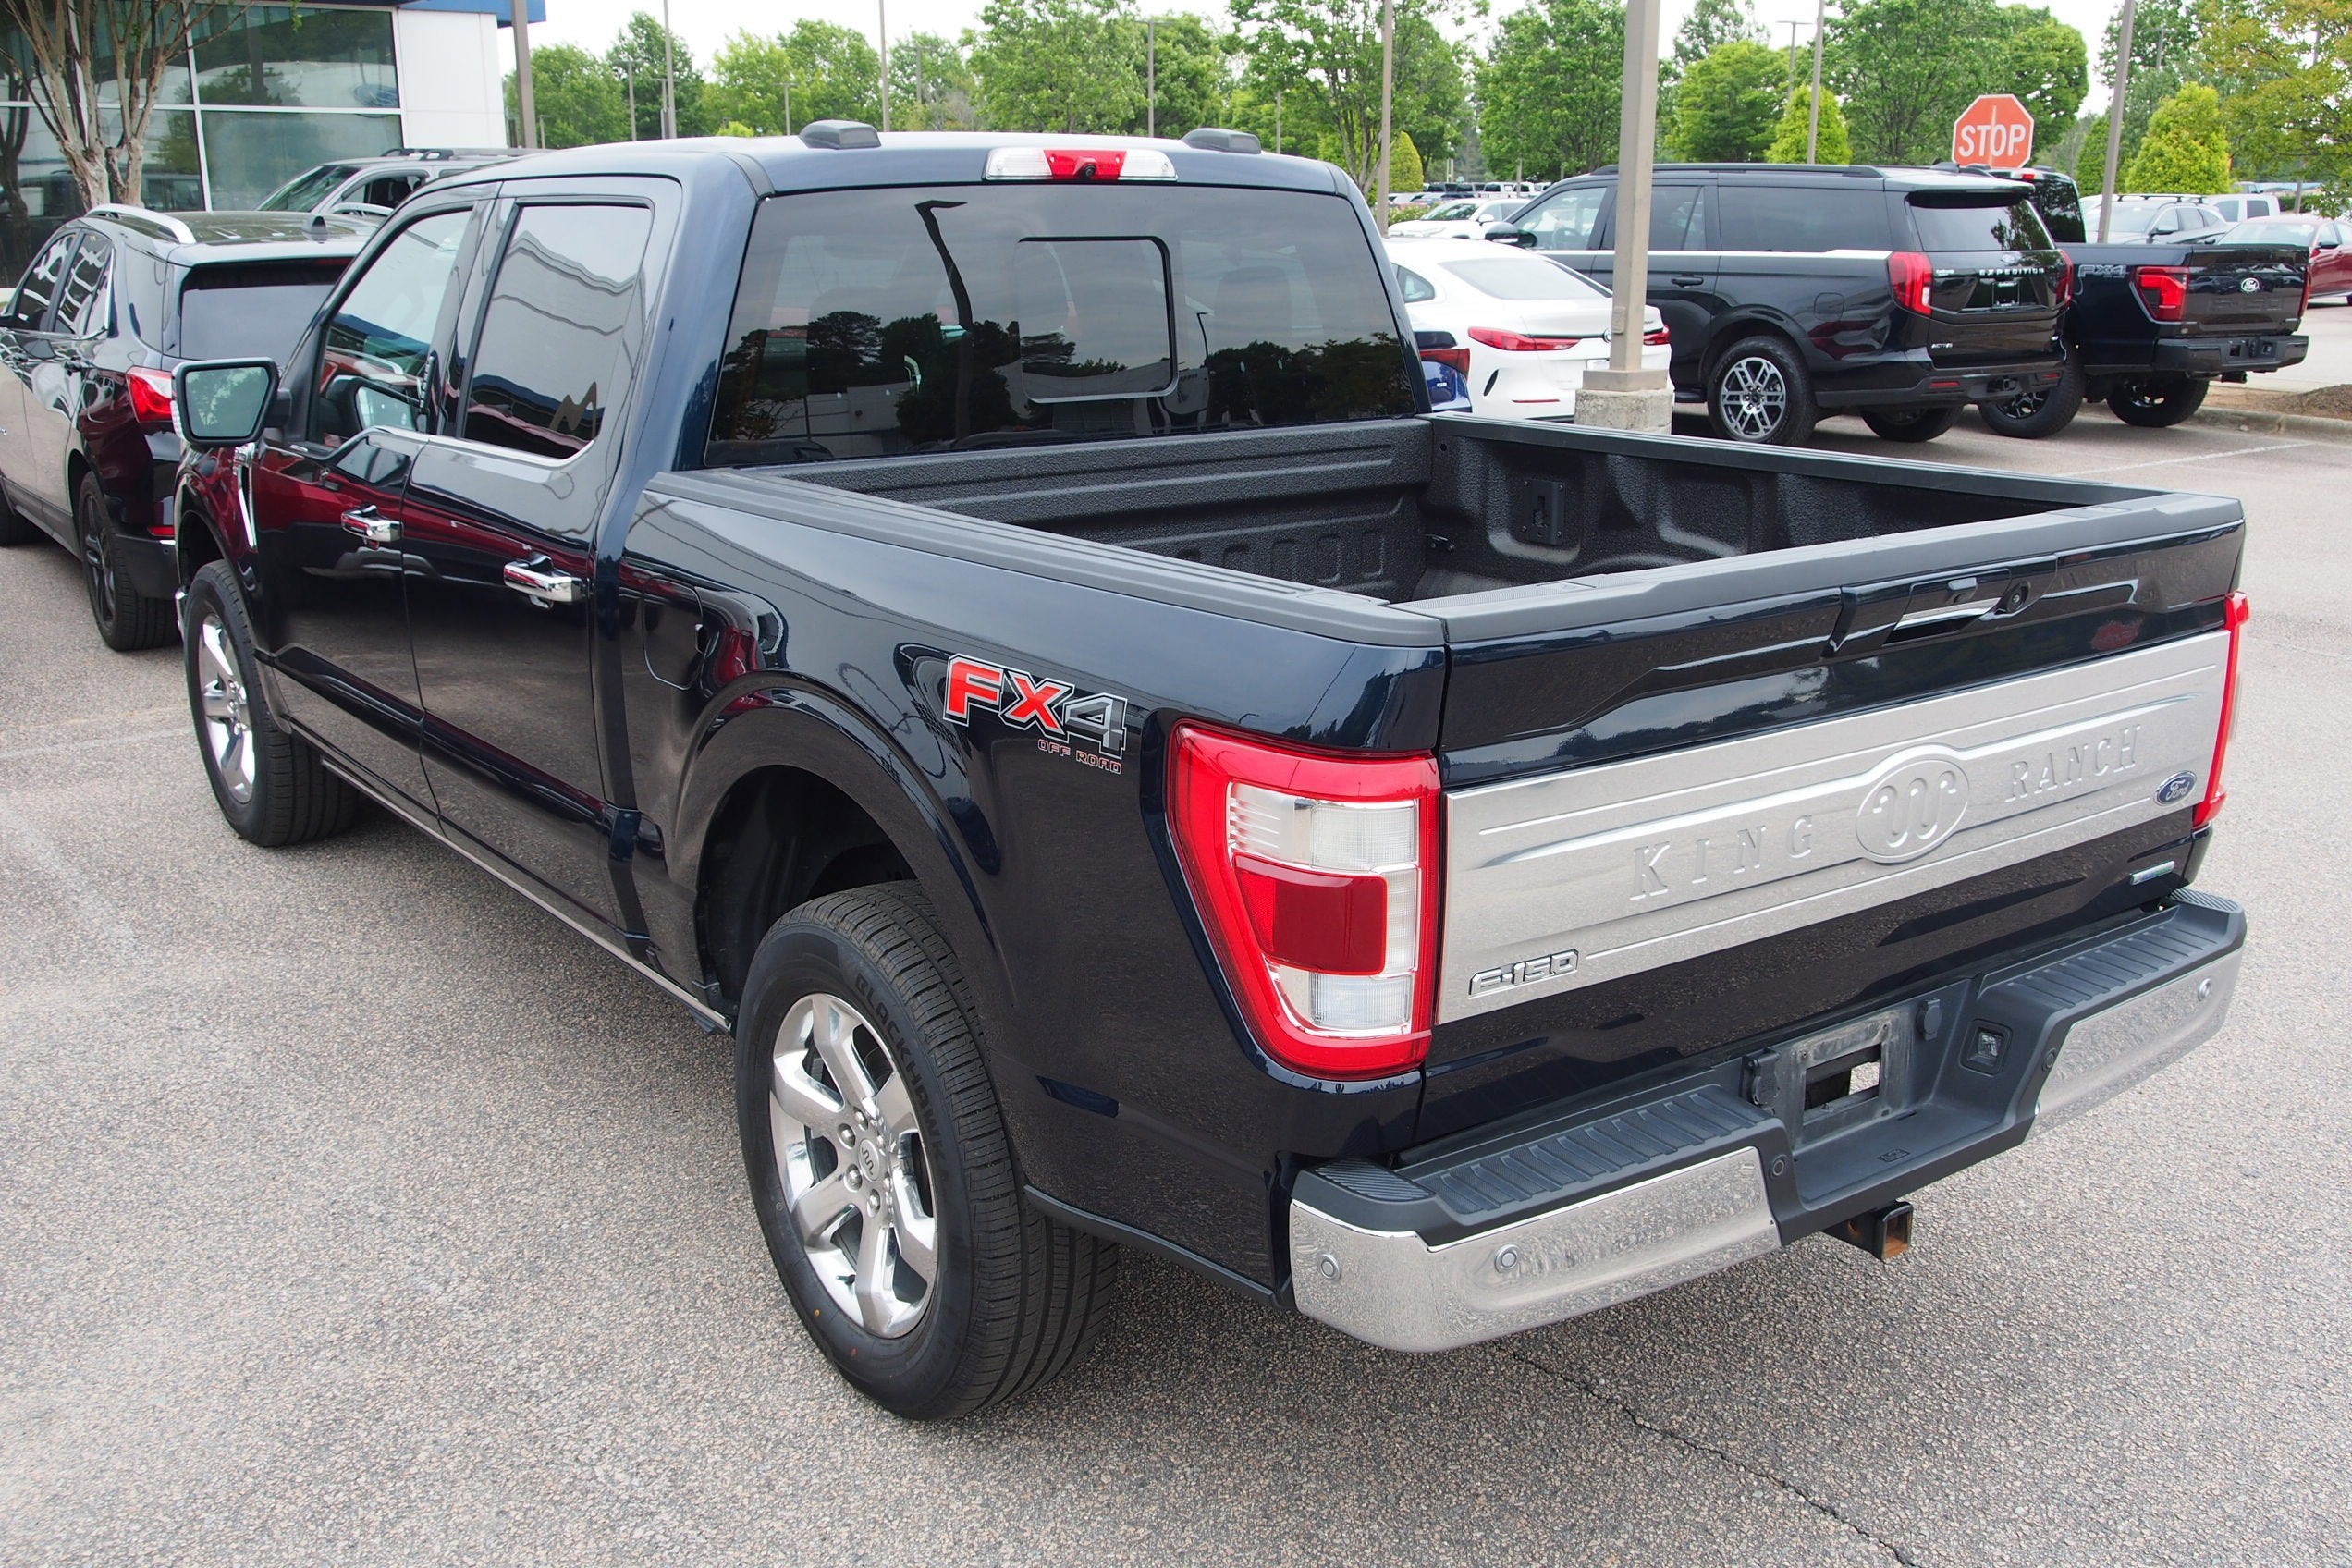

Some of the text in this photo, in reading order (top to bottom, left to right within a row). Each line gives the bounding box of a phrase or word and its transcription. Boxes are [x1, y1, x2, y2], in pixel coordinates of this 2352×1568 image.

[1959, 123, 2027, 157] STOP
[1978, 267, 2045, 276] EXPEDITION
[2078, 264, 2126, 277] FX4
[943, 653, 1128, 760] FX4
[1038, 739, 1122, 775] OFF ROAD
[2164, 779, 2191, 802] Ford
[1630, 723, 2141, 901] KING RANCH
[1468, 948, 1579, 1000] F-150
[854, 973, 946, 1161] BLACKHAWK
